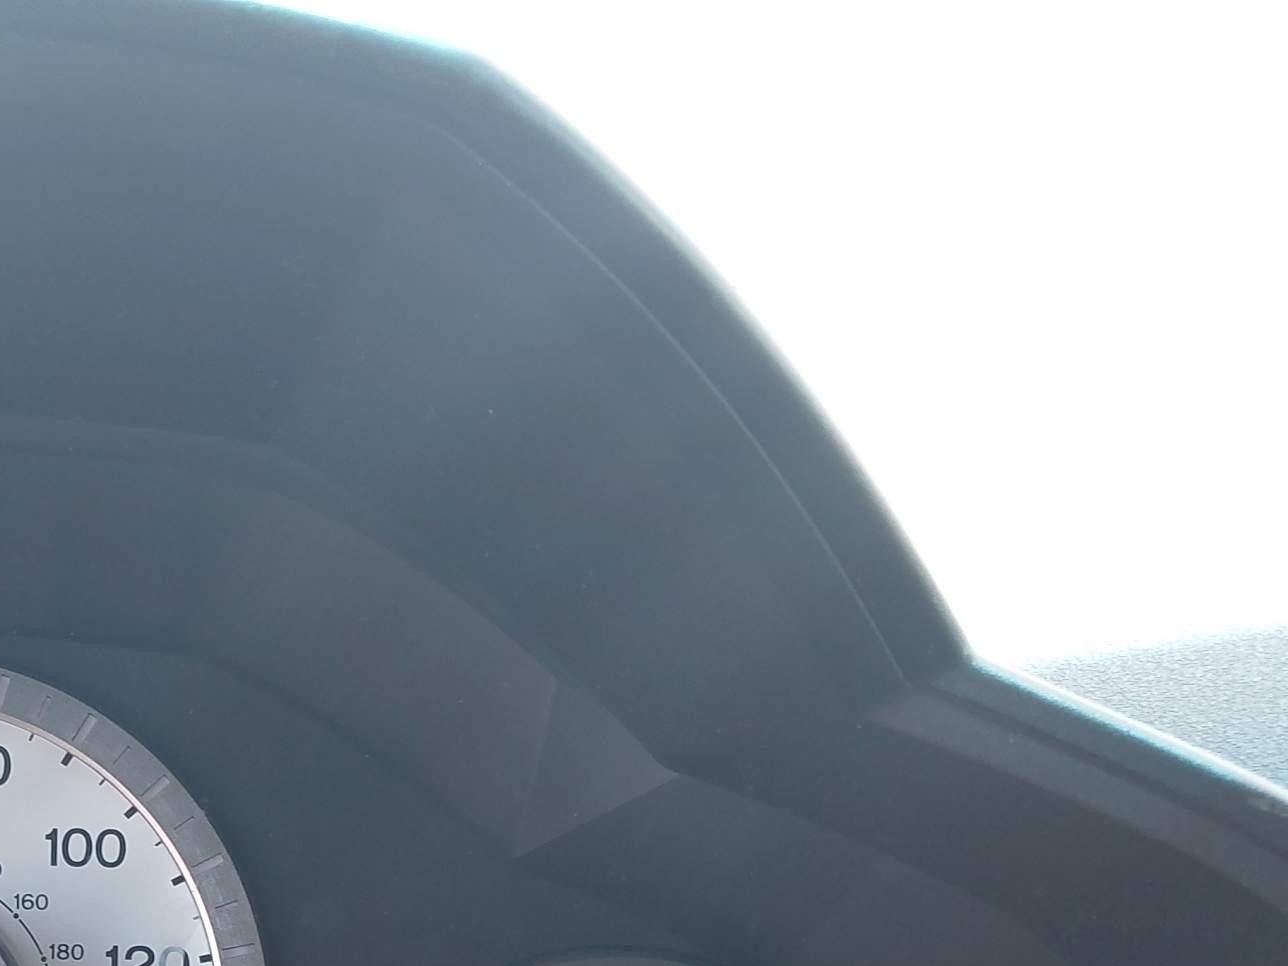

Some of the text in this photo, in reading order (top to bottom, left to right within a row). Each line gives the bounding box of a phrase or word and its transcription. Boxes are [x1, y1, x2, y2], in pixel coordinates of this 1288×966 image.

[46, 828, 125, 867] 100
[14, 895, 47, 910] 160
[50, 944, 83, 960] 180
